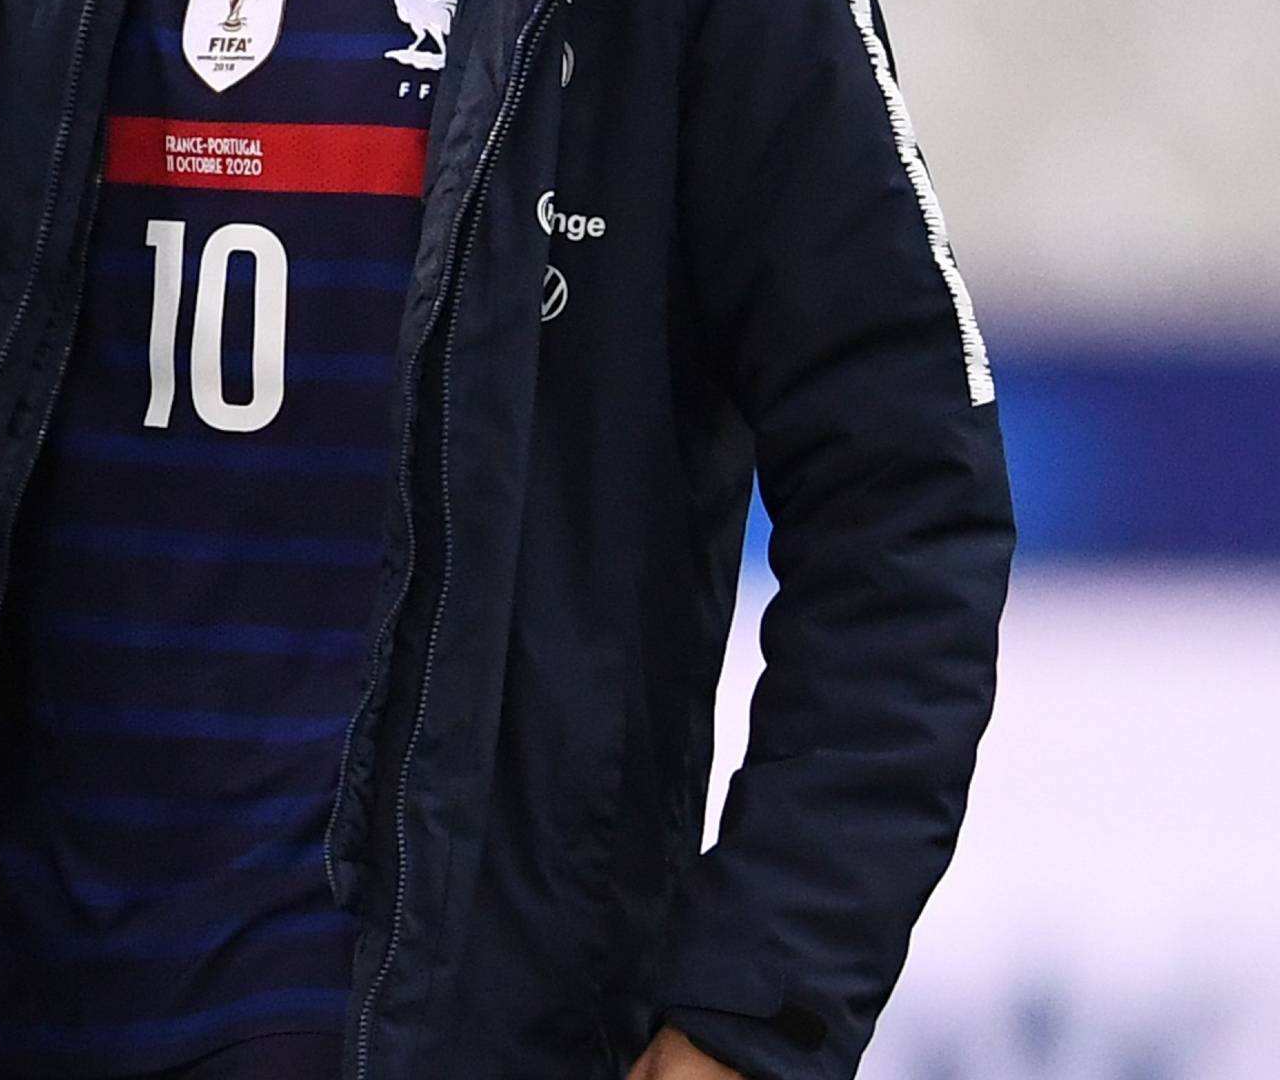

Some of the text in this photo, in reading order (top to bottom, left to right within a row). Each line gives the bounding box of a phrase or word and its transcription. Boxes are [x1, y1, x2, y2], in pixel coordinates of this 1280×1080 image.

[208, 37, 247, 52] FIFA
[399, 81, 430, 99] FF
[165, 134, 264, 156] FRANCE-PORTUGAL
[176, 156, 223, 175] OCTOBRE
[225, 158, 262, 176] 2020
[144, 220, 288, 432] 10
